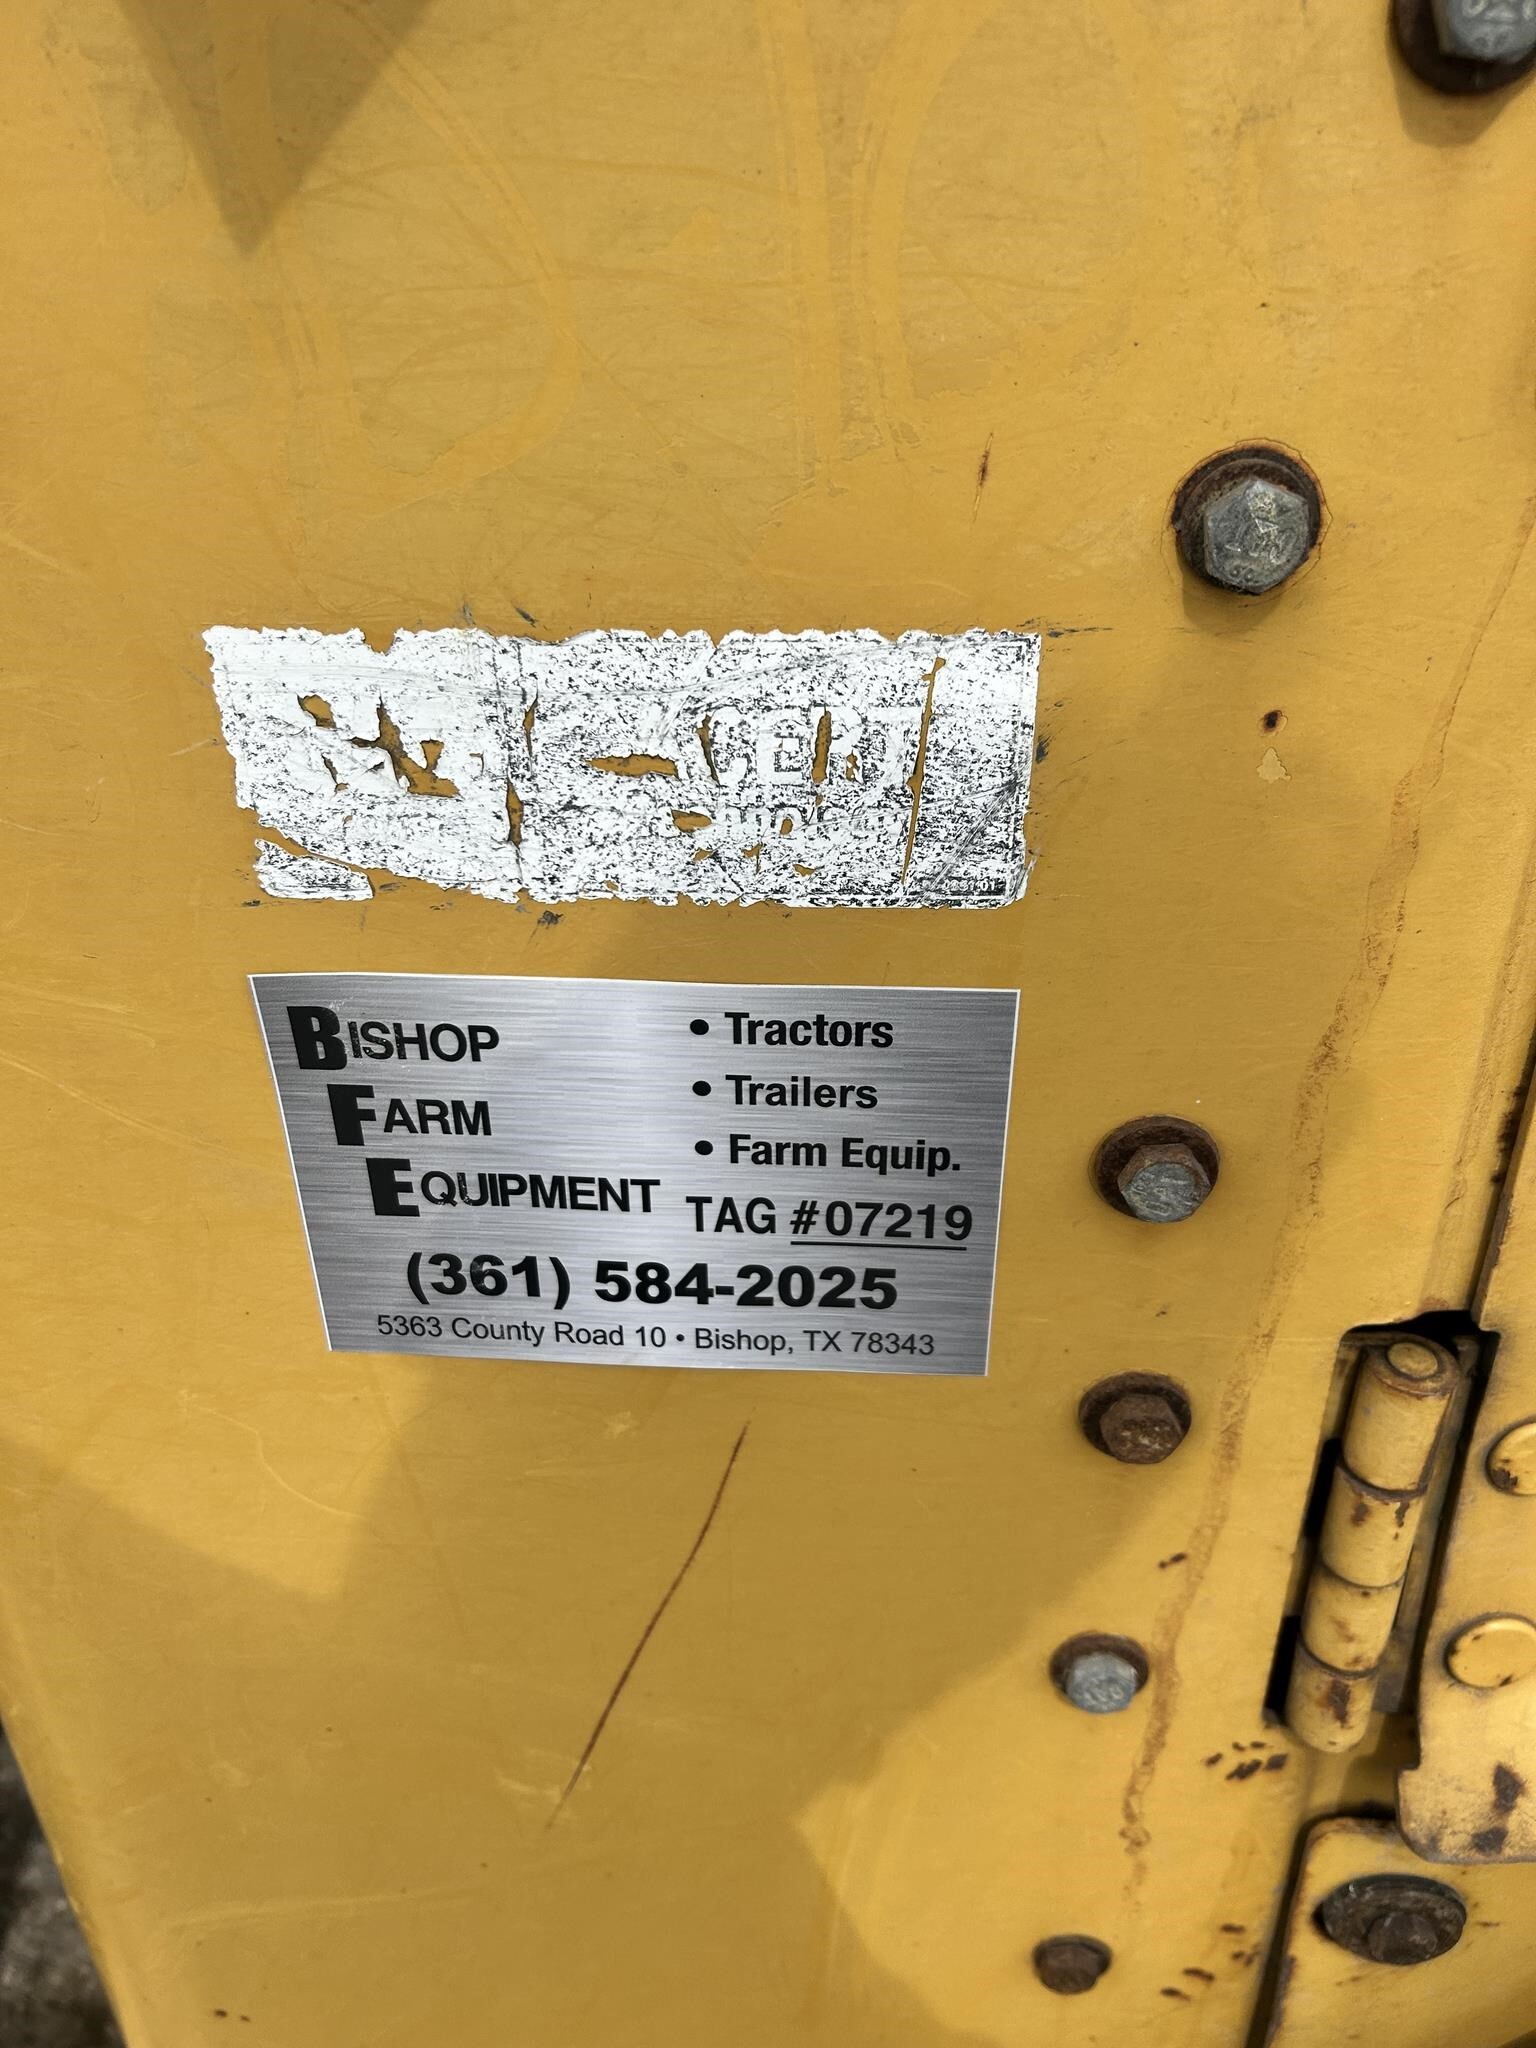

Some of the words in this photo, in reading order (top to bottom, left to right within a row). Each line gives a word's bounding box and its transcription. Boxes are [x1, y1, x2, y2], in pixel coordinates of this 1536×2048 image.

[287, 1005, 499, 1070] BISHOP
[724, 1011, 894, 1048] Tractors
[327, 1083, 492, 1146] FARM
[725, 1074, 878, 1109] Trailers
[729, 1133, 827, 1167] Farm
[842, 1137, 960, 1177] Equip.
[366, 1158, 660, 1217] EQUIPMENT
[685, 1195, 777, 1234] TAG
[790, 1199, 973, 1241] #07219
[407, 1252, 571, 1310] (361)
[595, 1260, 898, 1309] 584-2025
[376, 1314, 443, 1338] 5363
[451, 1317, 545, 1347] County
[554, 1321, 624, 1346] Road
[636, 1325, 667, 1348] 10
[695, 1328, 795, 1356] Bishop,
[803, 1330, 842, 1353] TX
[851, 1331, 935, 1356] 78343
